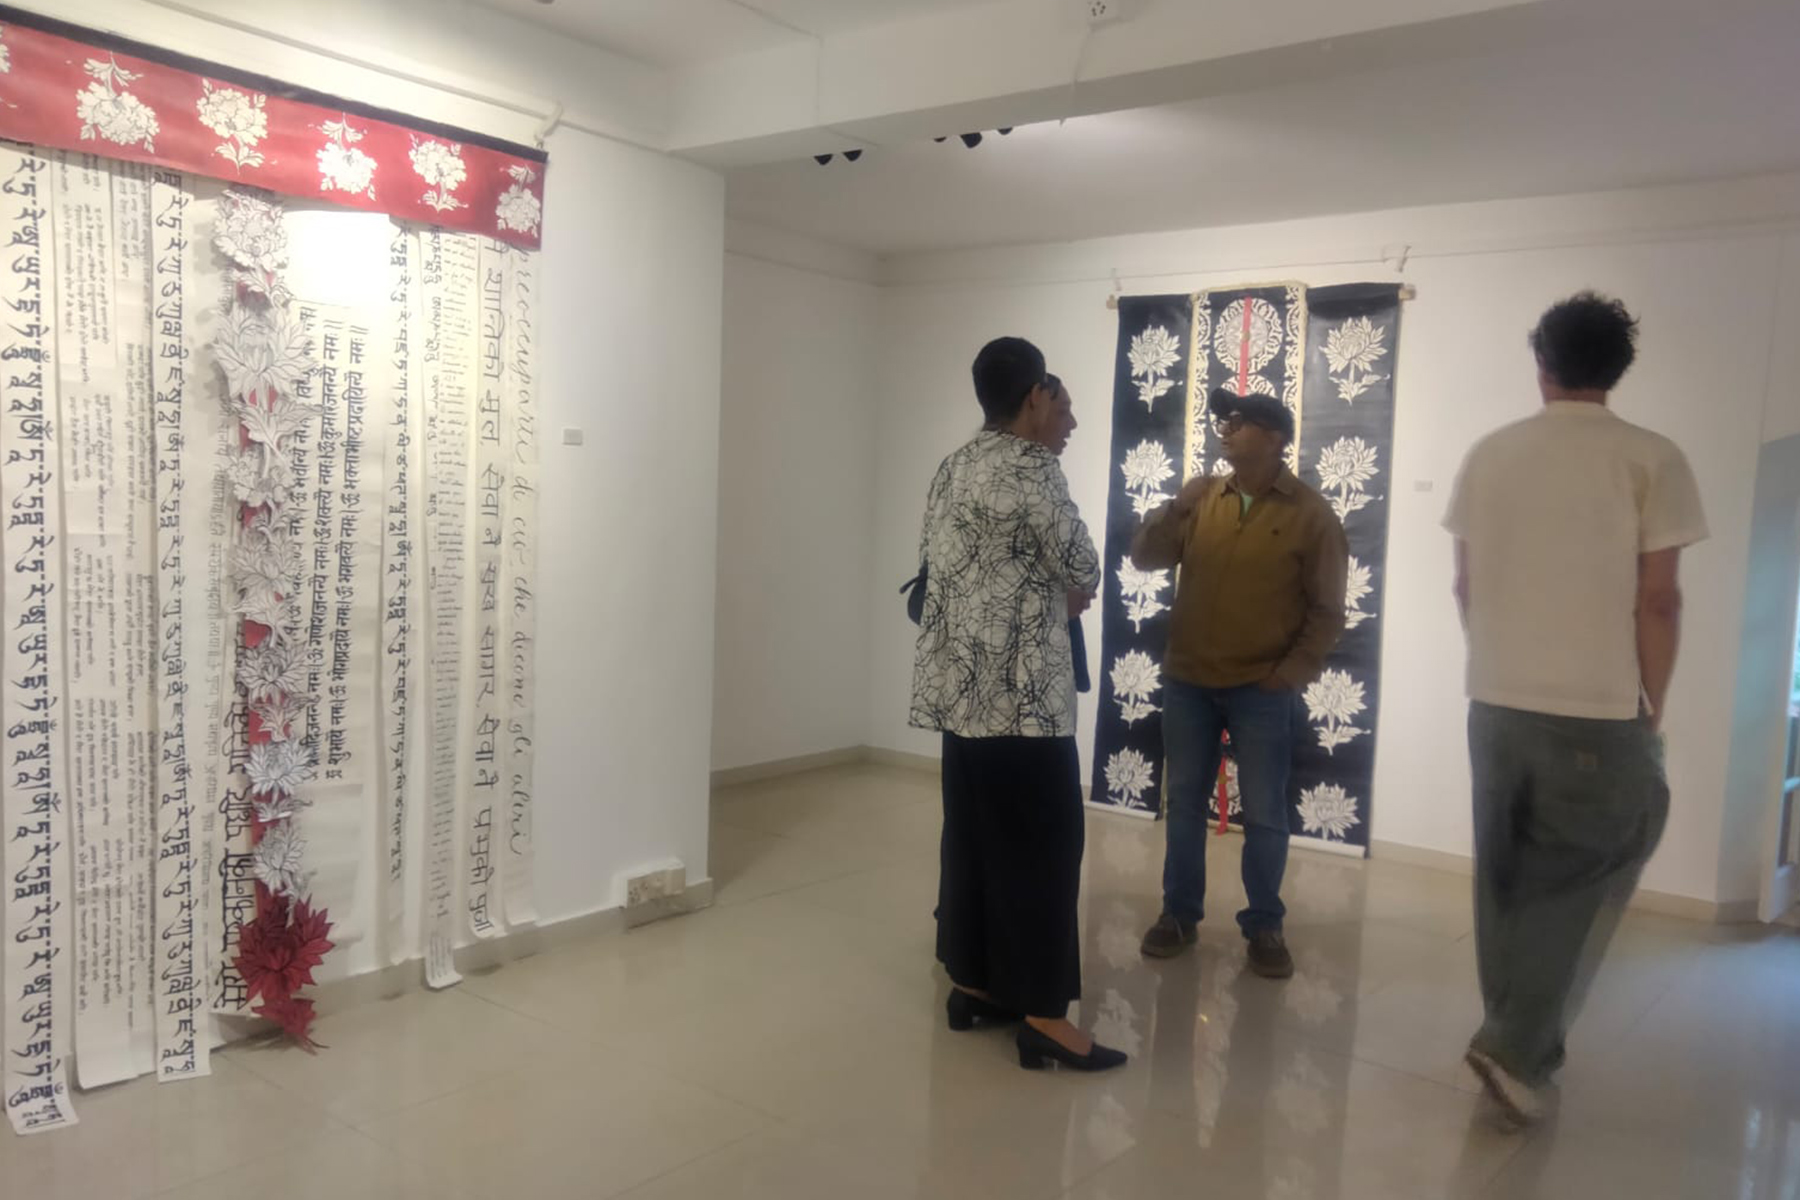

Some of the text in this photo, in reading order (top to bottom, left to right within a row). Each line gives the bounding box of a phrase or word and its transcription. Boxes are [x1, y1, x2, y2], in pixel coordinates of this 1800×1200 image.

[511, 476, 536, 502] di
[513, 576, 533, 619] che
[507, 718, 533, 758] gli
